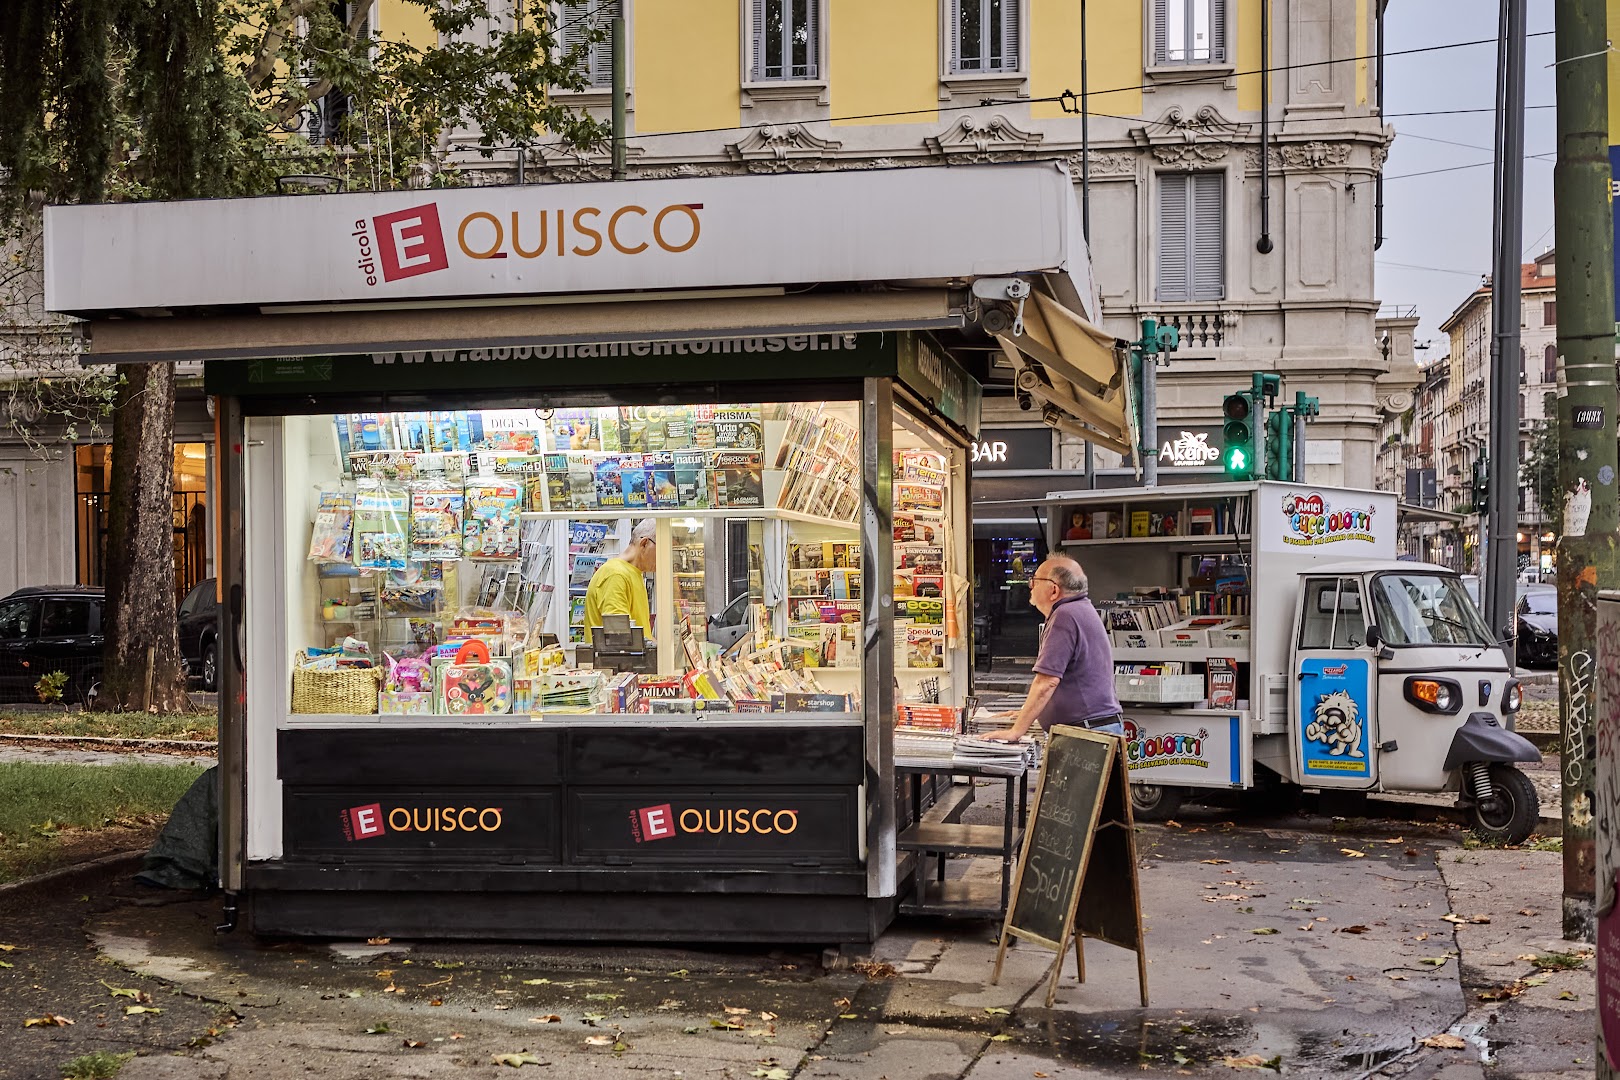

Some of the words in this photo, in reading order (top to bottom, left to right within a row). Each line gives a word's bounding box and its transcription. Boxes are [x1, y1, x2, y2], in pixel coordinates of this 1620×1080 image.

[351, 218, 377, 287] edicola
[713, 411, 753, 420] PRISMA
[1298, 501, 1322, 513] AMICI
[1291, 511, 1371, 536] CUCCIOLOTTI
[907, 628, 944, 637] SpeakUp
[1212, 674, 1232, 684] AUTO
[1139, 758, 1168, 769] SALVANO
[1169, 757, 1179, 765] GLI
[1180, 757, 1209, 768] ANIMALI
[339, 808, 353, 843] edicola
[628, 809, 642, 844] edicola
